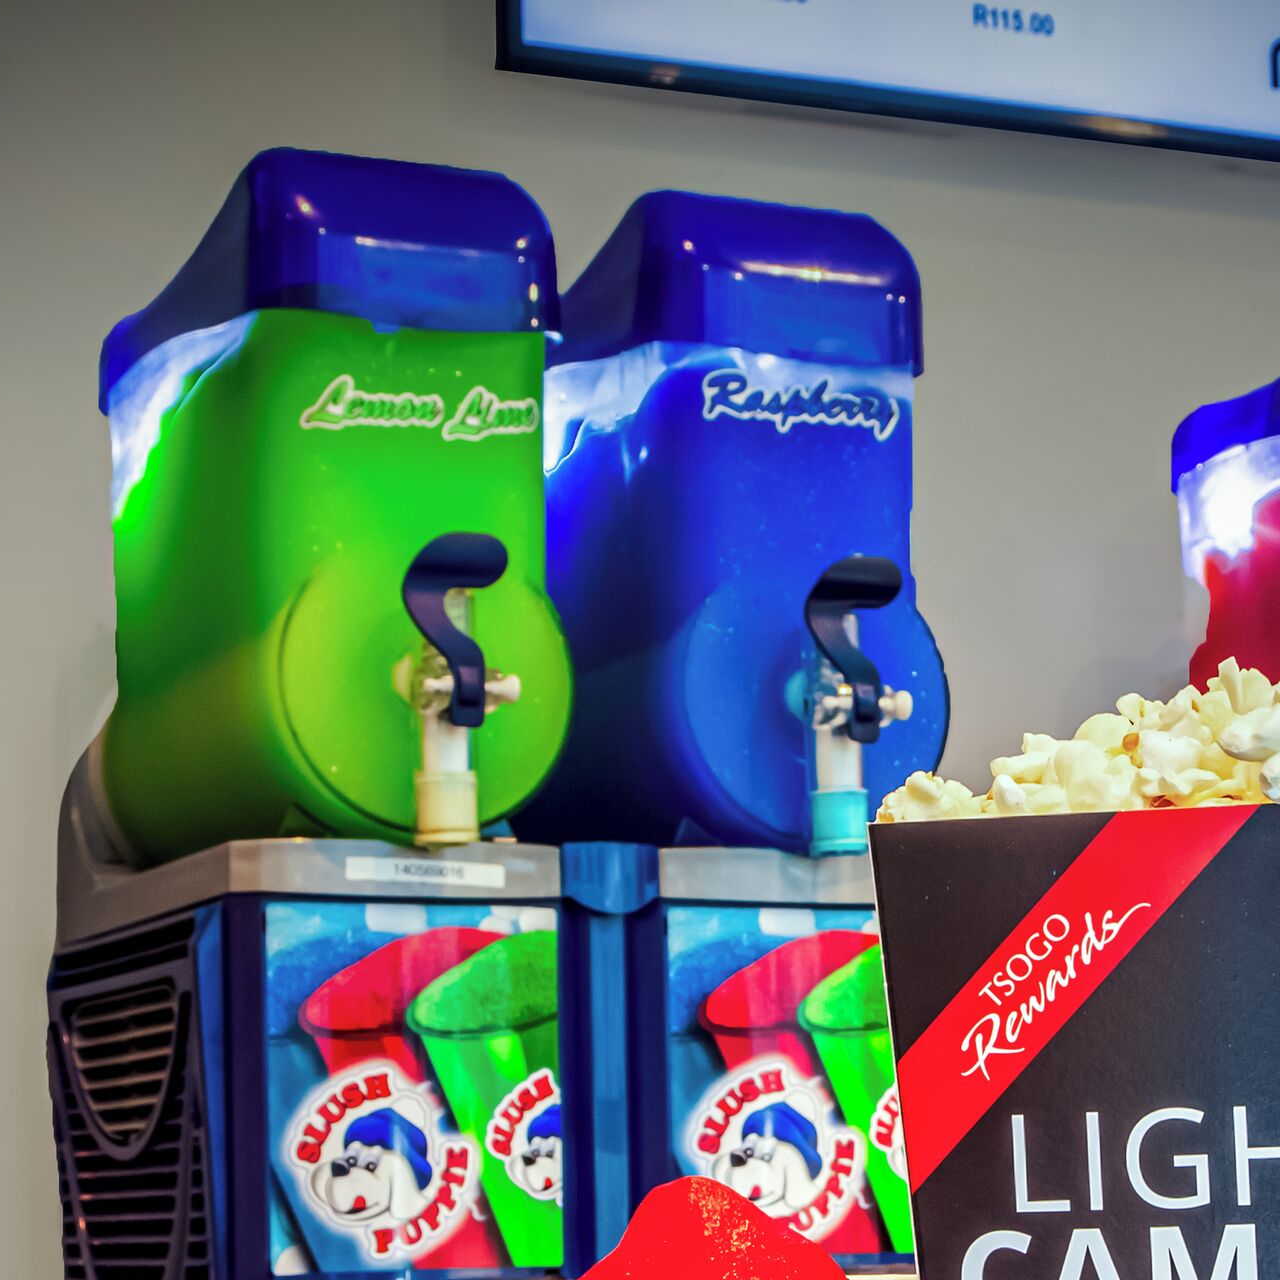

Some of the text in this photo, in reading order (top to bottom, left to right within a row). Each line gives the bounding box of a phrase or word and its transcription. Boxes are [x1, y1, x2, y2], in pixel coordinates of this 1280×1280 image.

[973, 3, 1054, 37] R115.00
[301, 374, 540, 441] Lemon Lime
[702, 370, 900, 440] Raspberry
[961, 902, 1151, 1081] Rewards
[978, 914, 1069, 1006] TSOGO
[297, 1073, 391, 1163] SLUSH
[491, 1075, 554, 1156] SLUSH
[697, 1069, 785, 1154] SLUSH
[373, 1148, 468, 1253] PUPPIE
[789, 1139, 855, 1232] UPPIE
